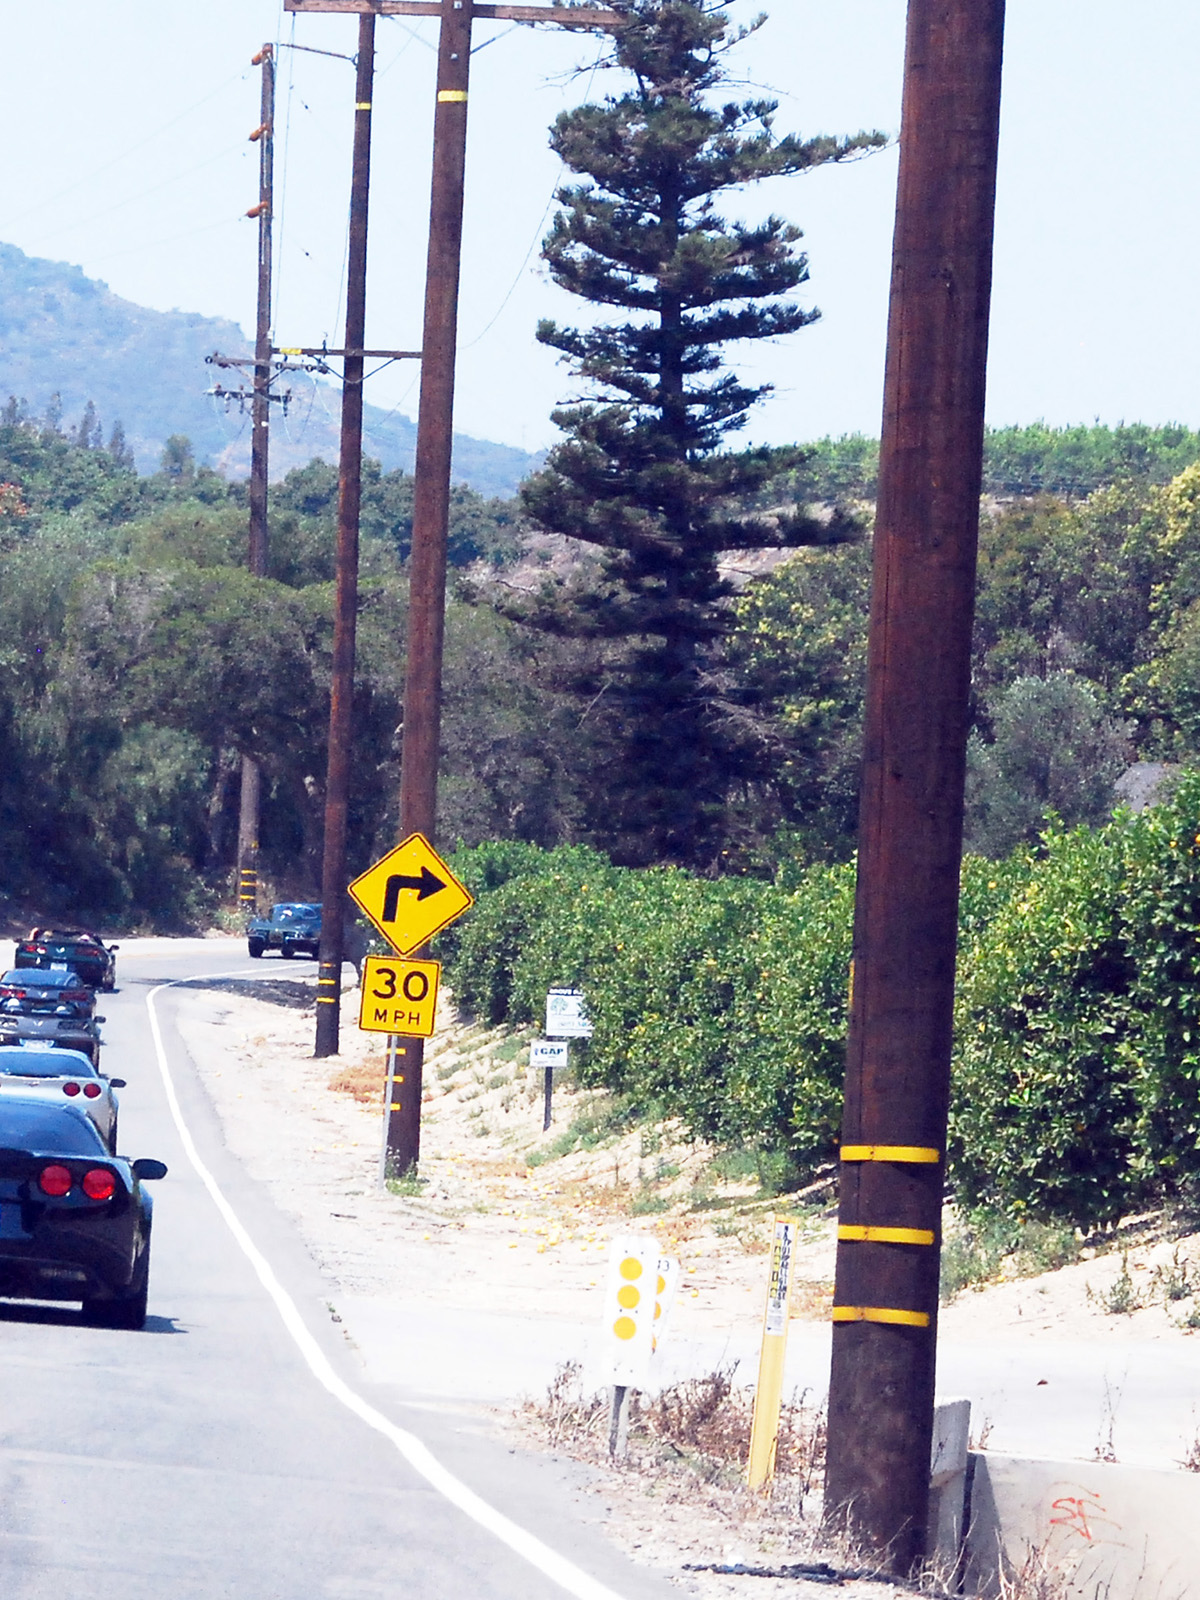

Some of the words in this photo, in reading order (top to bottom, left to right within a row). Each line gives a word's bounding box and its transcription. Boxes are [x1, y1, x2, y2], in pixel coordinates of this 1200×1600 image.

[372, 967, 429, 1002] 30
[374, 1008, 420, 1026] MPH
[540, 1047, 564, 1055] GAP
